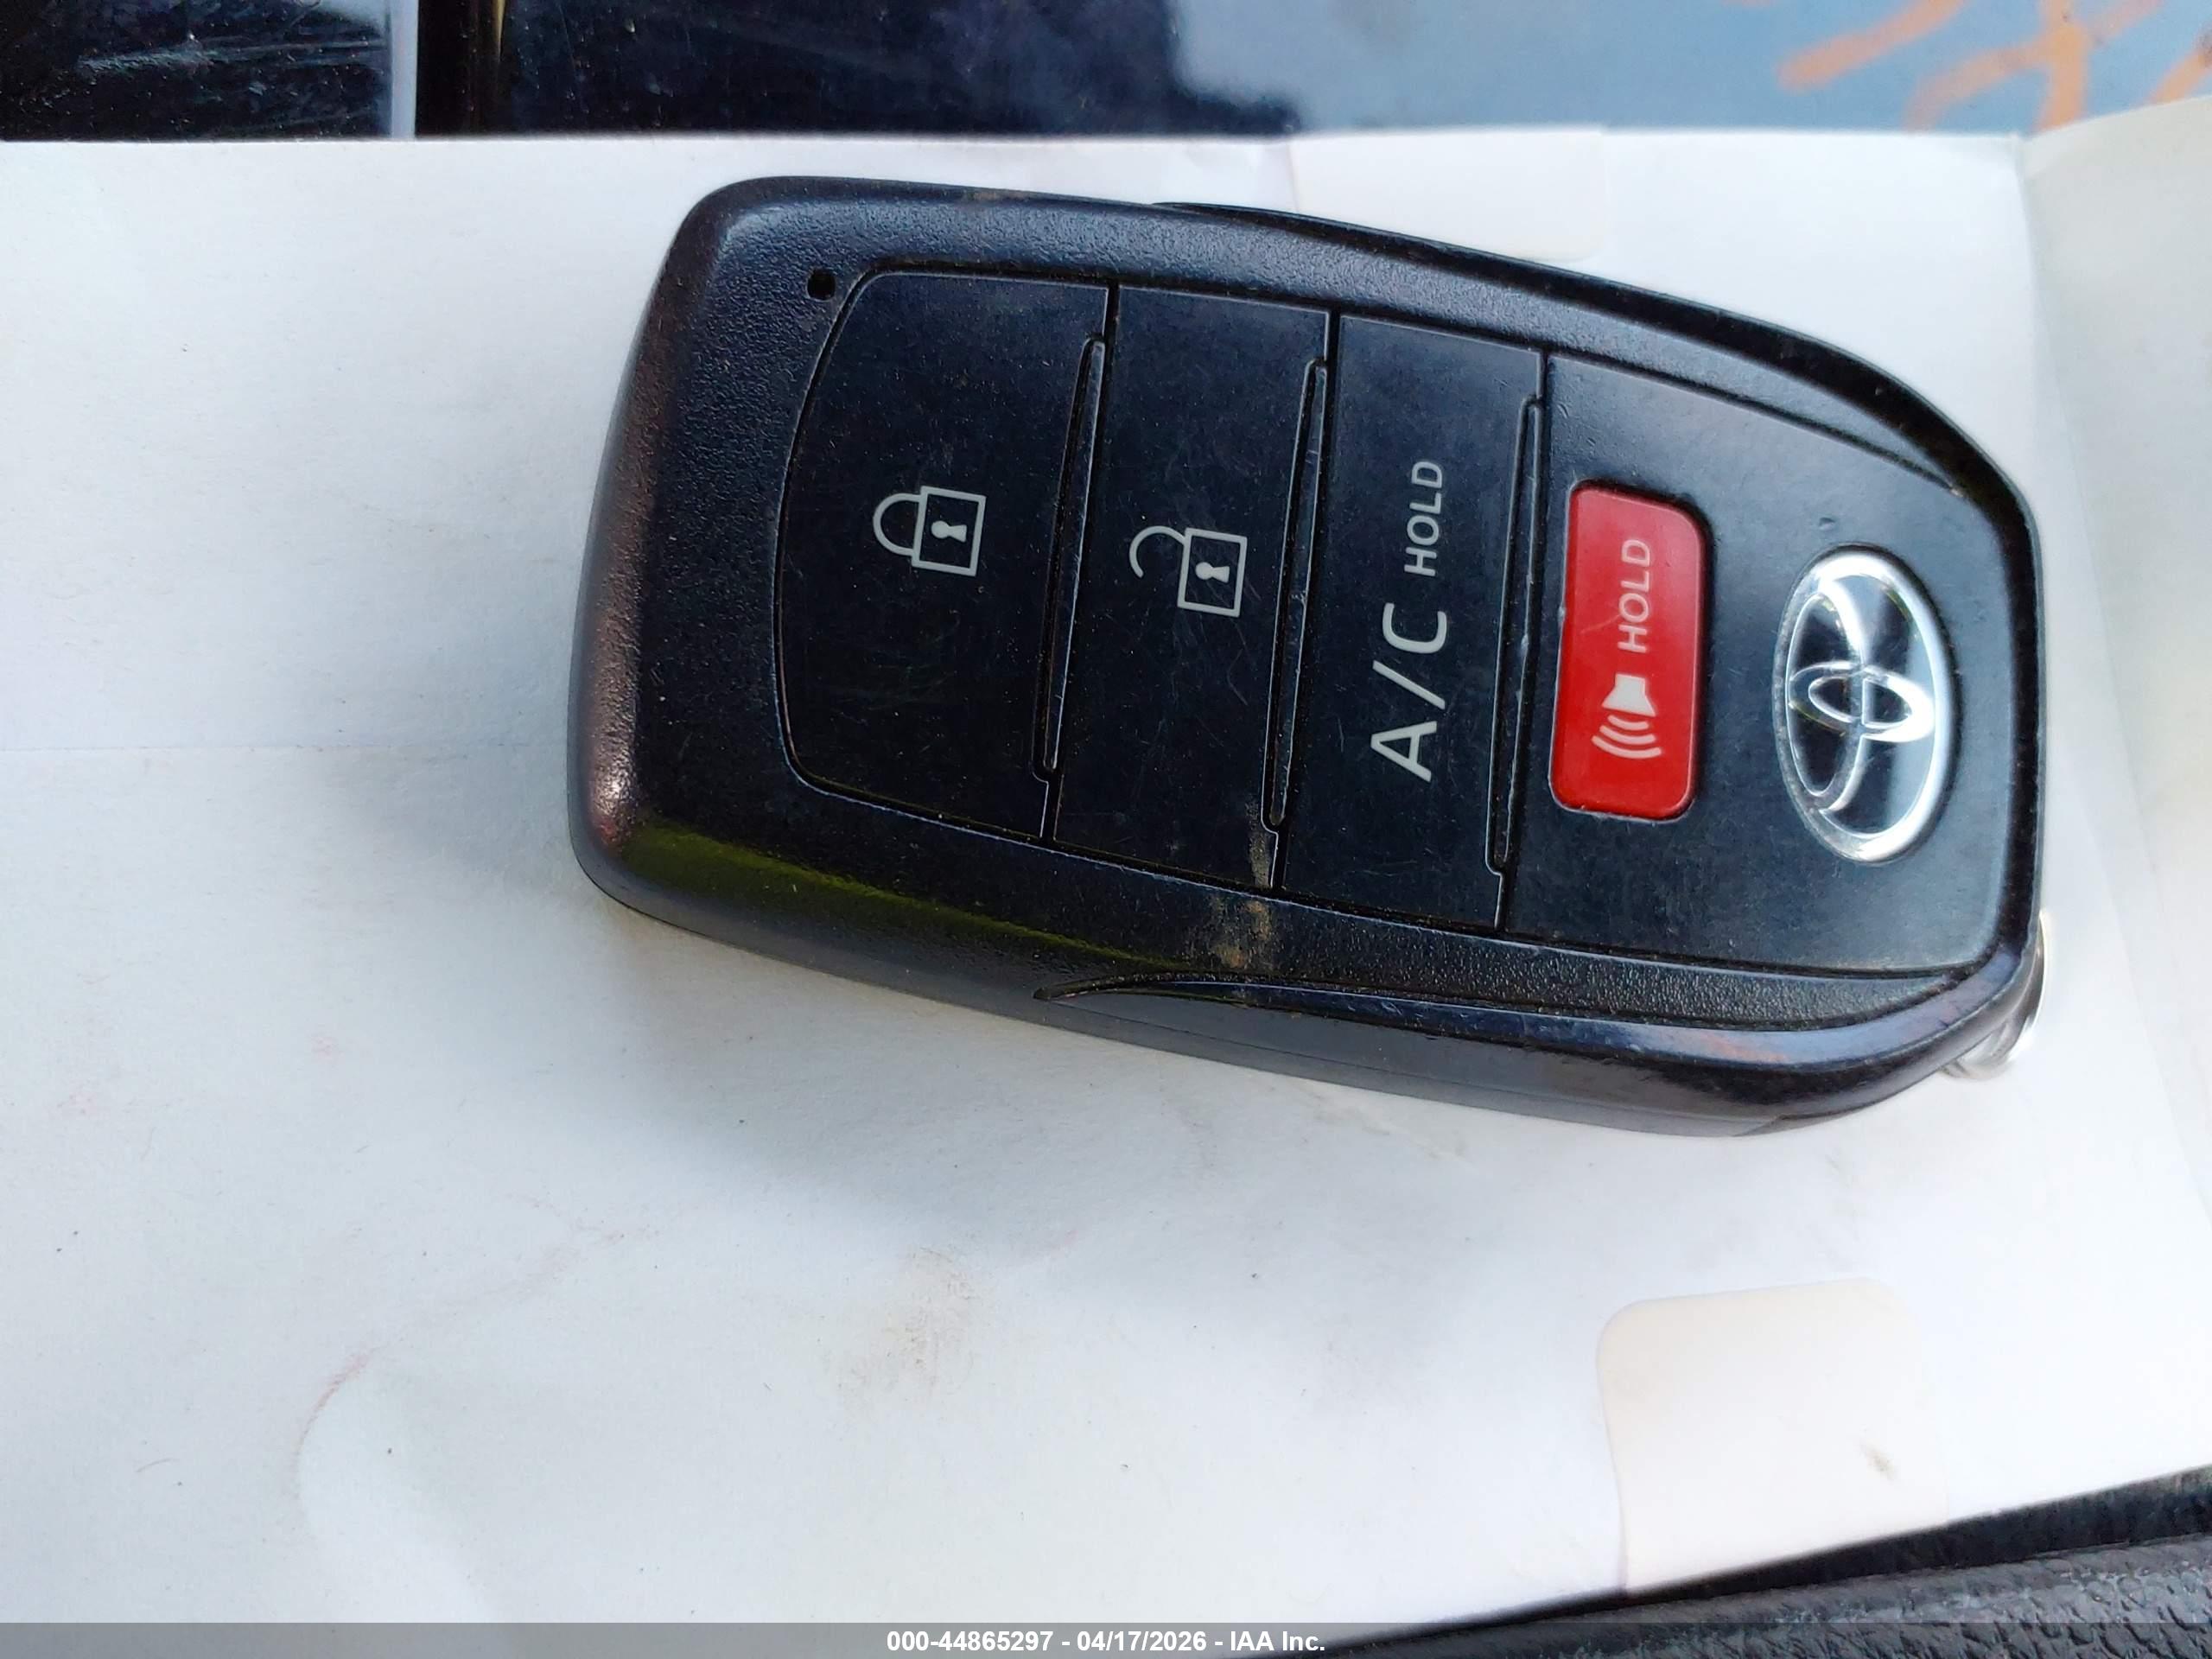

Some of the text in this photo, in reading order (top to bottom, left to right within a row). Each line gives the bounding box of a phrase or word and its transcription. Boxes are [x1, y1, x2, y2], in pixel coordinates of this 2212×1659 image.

[1370, 461, 1447, 783] A/C HOLD
[1618, 539, 1651, 654] HOLD
